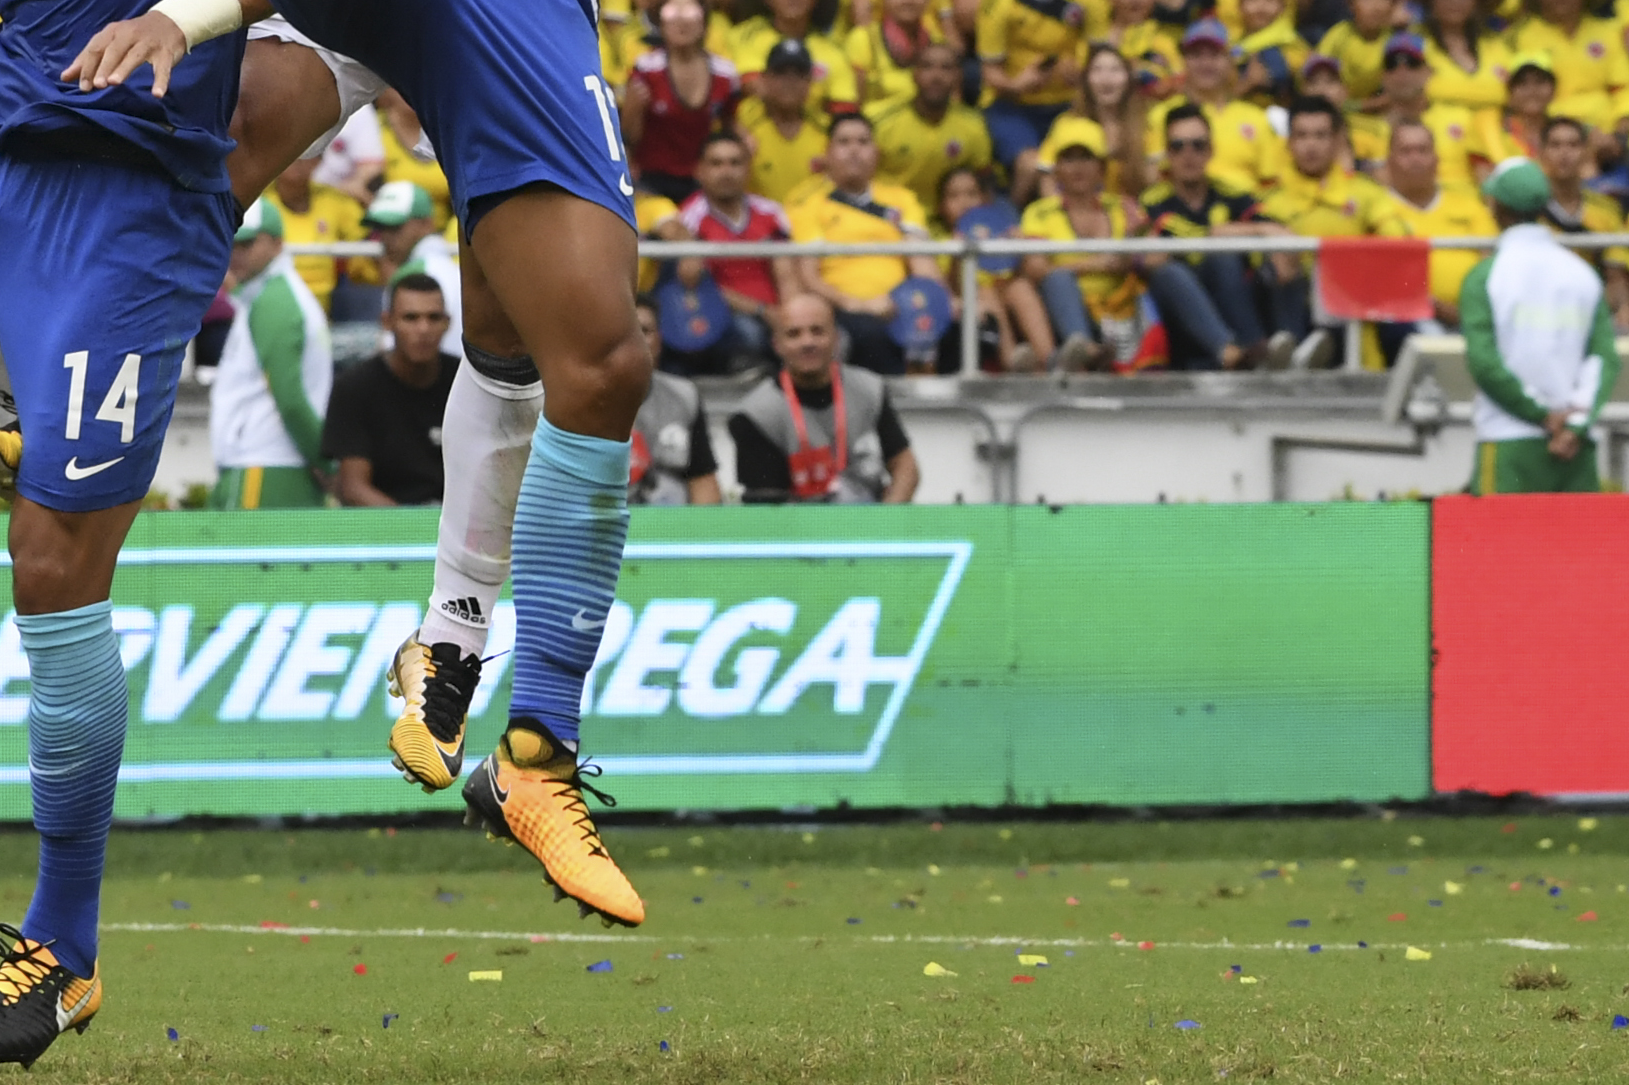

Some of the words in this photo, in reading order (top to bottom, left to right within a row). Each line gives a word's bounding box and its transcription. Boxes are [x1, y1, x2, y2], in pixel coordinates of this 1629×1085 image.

[583, 74, 626, 162] 1
[63, 350, 142, 444] 14
[441, 602, 486, 624] adidas
